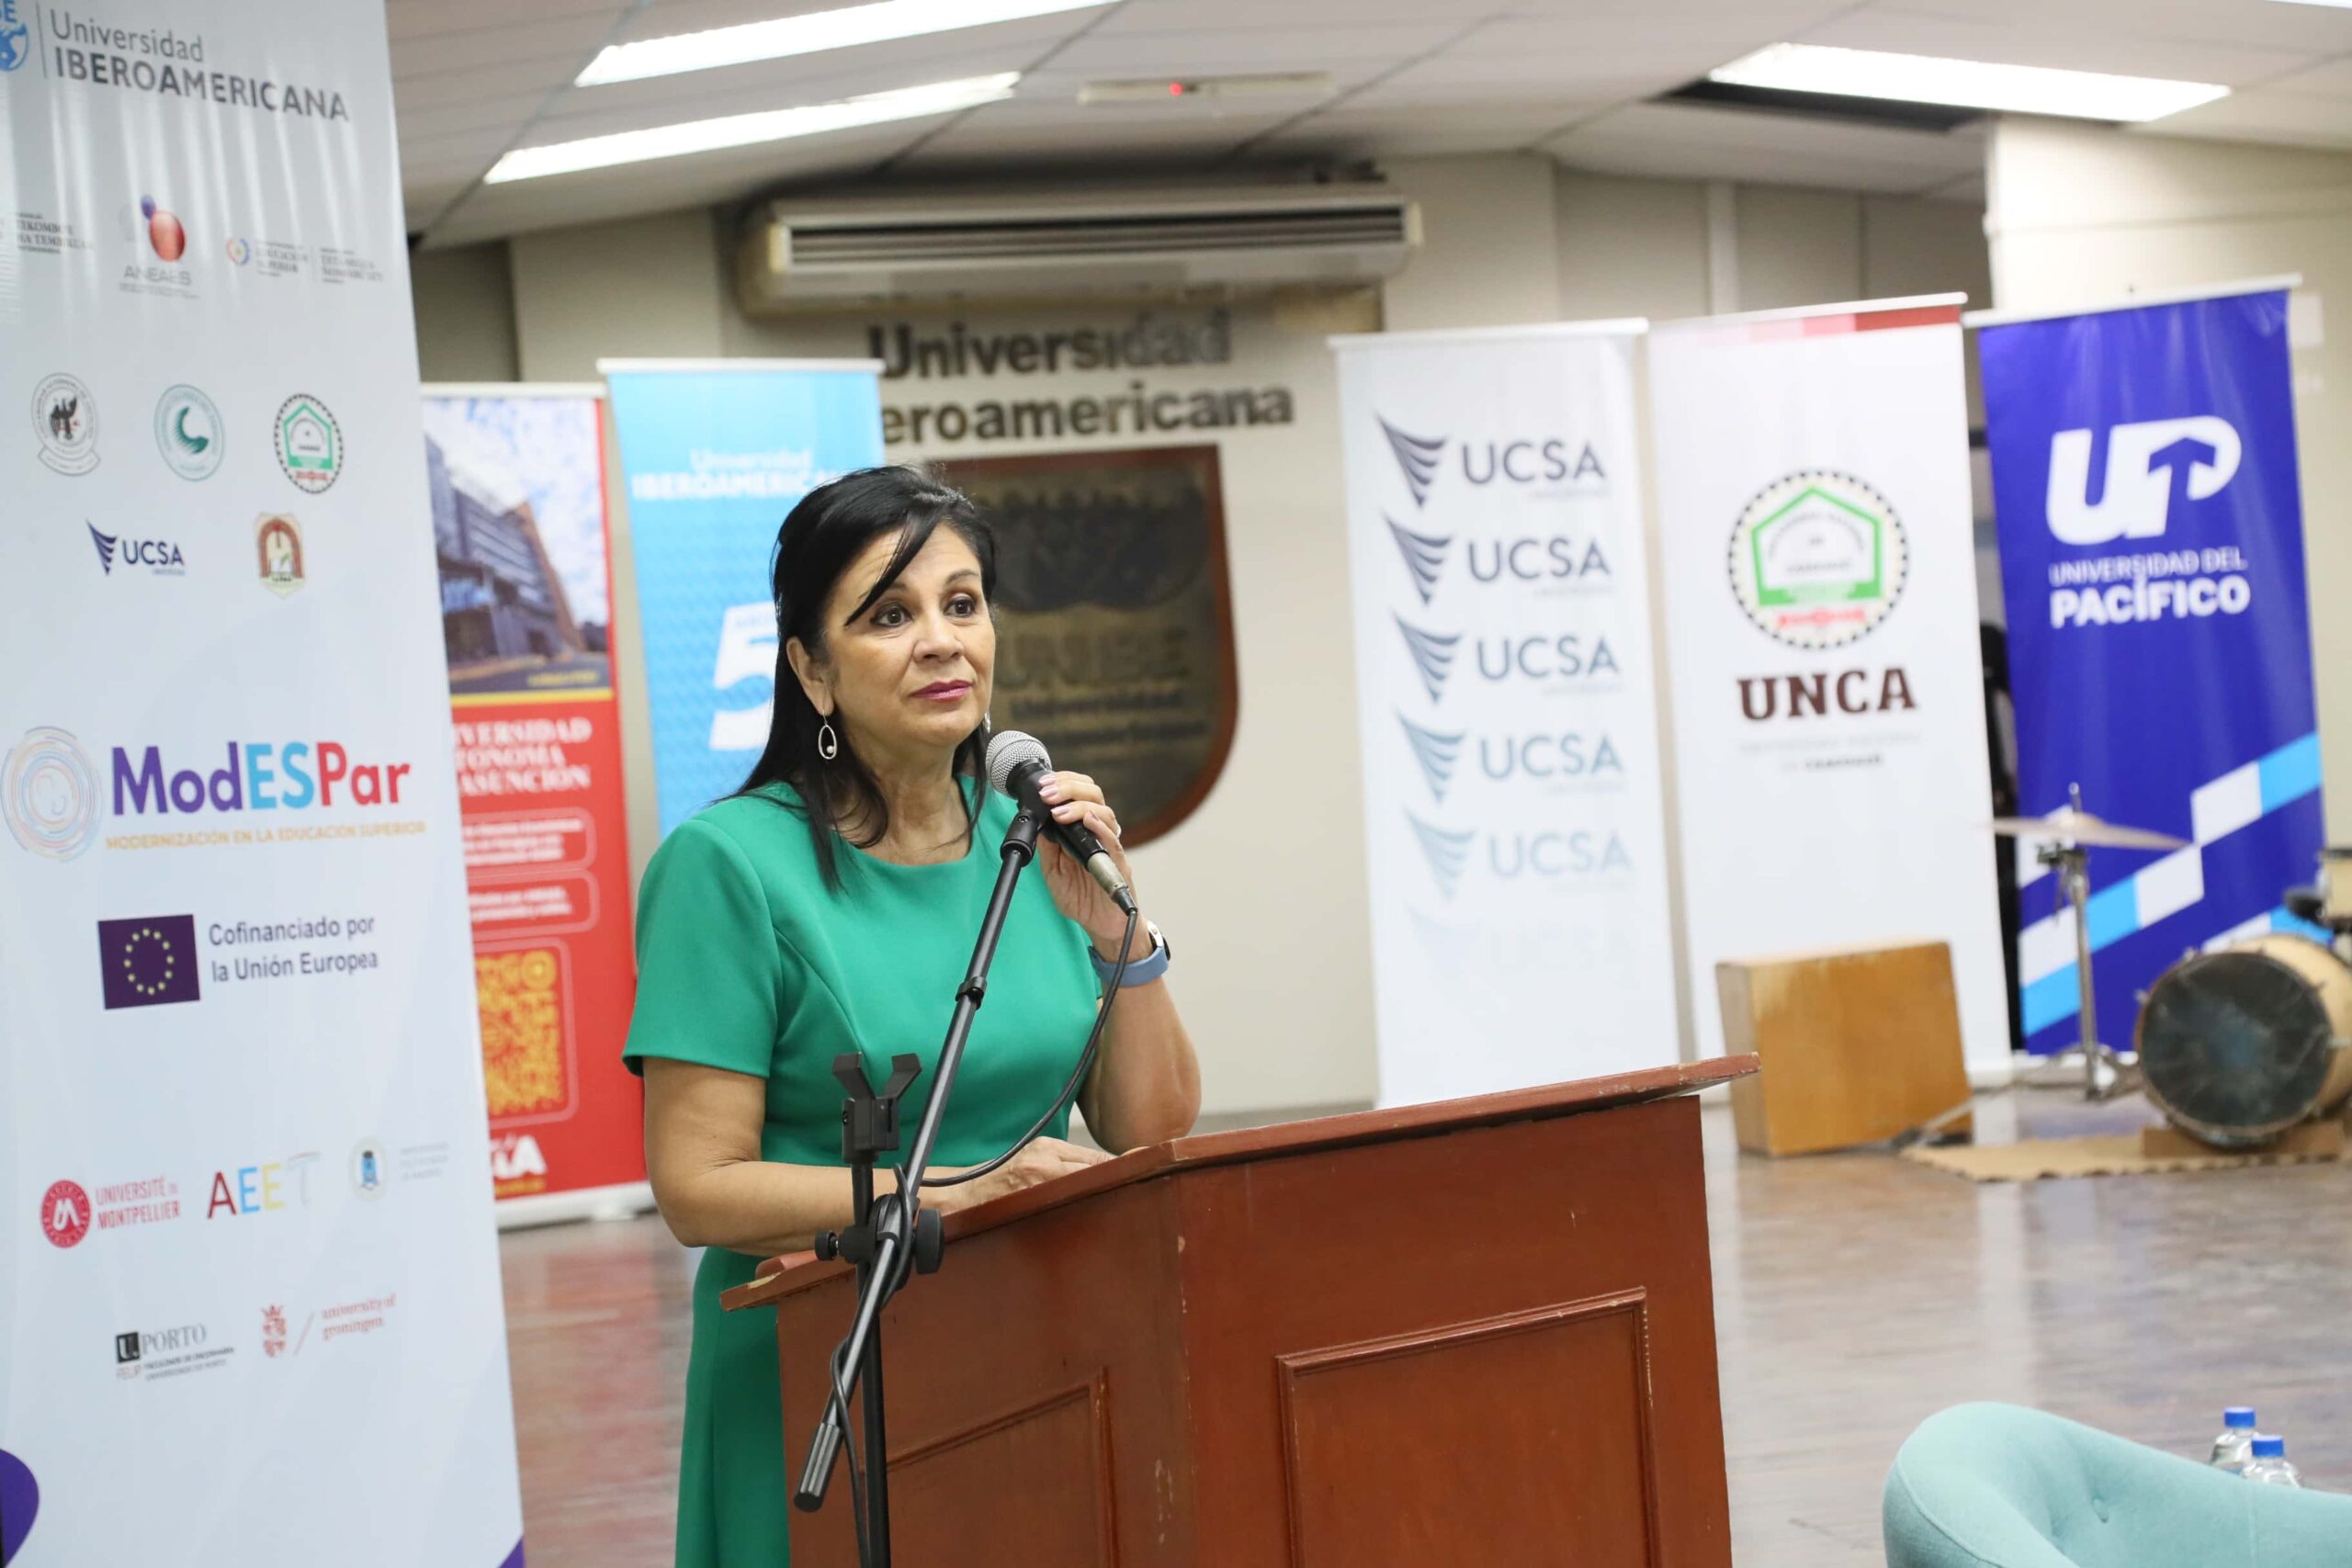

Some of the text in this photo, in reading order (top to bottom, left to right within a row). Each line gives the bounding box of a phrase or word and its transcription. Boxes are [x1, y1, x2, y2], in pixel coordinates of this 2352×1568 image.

[50, 9, 204, 63] Universidad
[55, 46, 350, 121] IBEROAMERICANA
[867, 310, 1232, 379] Universidad
[882, 381, 1295, 444] eroamericana
[1460, 438, 1606, 484] UCSA
[122, 539, 185, 567] UCSA
[1467, 537, 1611, 582] UCSA
[2048, 547, 2249, 587] UNIVERSIDAD DEL
[2050, 573, 2251, 629] PACÍFICO
[1475, 635, 1620, 681] UCSA
[1736, 666, 1917, 722] UNCA
[112, 741, 411, 816] ModESPar
[1478, 732, 1626, 780] UCSA
[106, 820, 426, 851] MODERNIZACIÓN EN LA EDUCACIÓN SUPERIOR
[1488, 829, 1633, 878] UCSA
[209, 917, 375, 946] Cofinanciado por
[212, 951, 378, 983] la Unión Europea
[97, 1200, 181, 1230] MONTPELLIER
